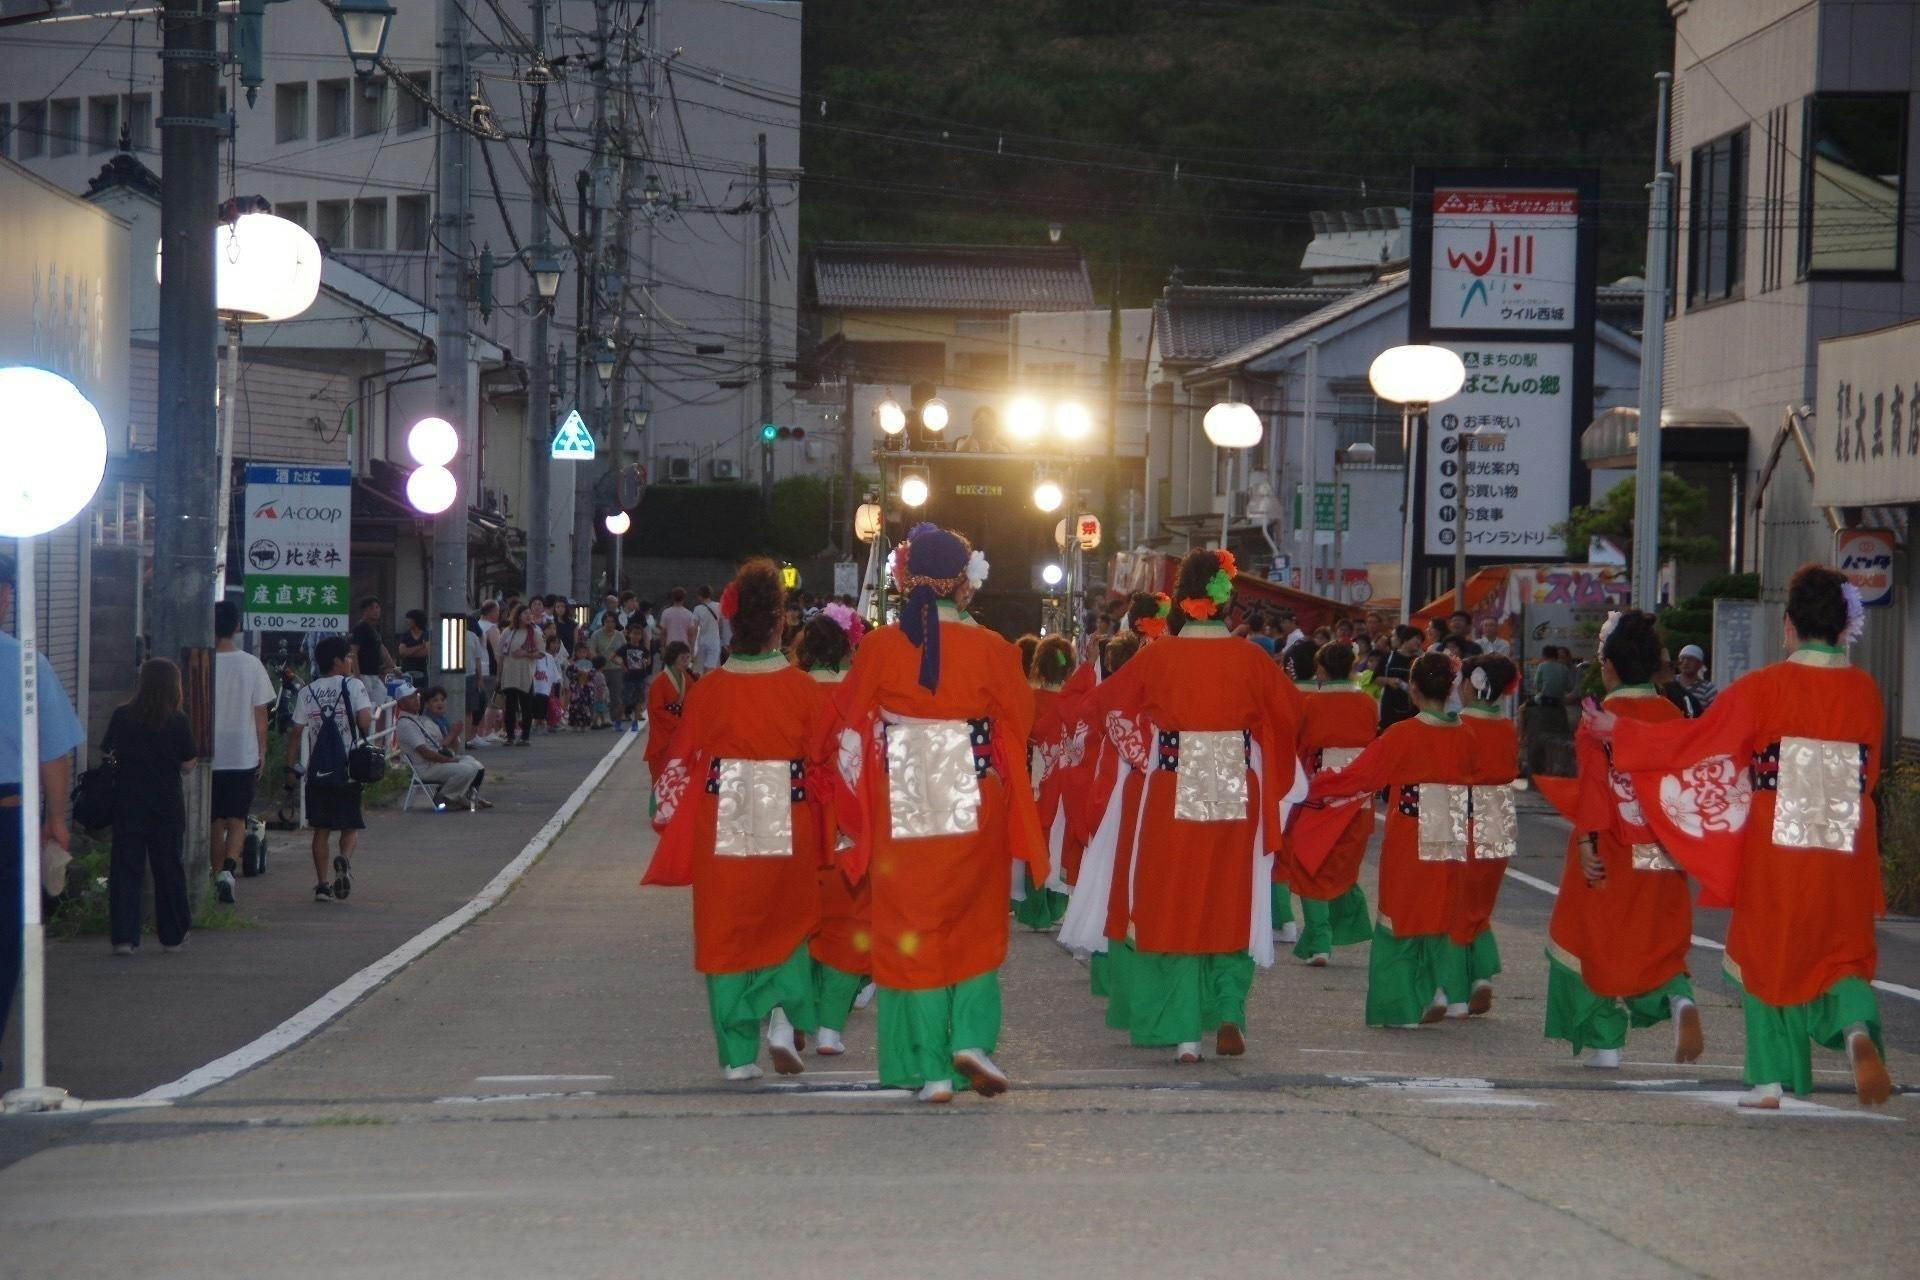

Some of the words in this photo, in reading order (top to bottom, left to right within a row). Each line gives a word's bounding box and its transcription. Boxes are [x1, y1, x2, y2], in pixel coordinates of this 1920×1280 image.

[1447, 220, 1534, 277] Will
[1482, 352, 1538, 368] まちの駅
[275, 469, 289, 484] 酒
[293, 471, 321, 484] たばこ
[1082, 520, 1097, 536] 祭
[286, 548, 342, 569] 比婆牛
[252, 584, 340, 606] 産直野菜
